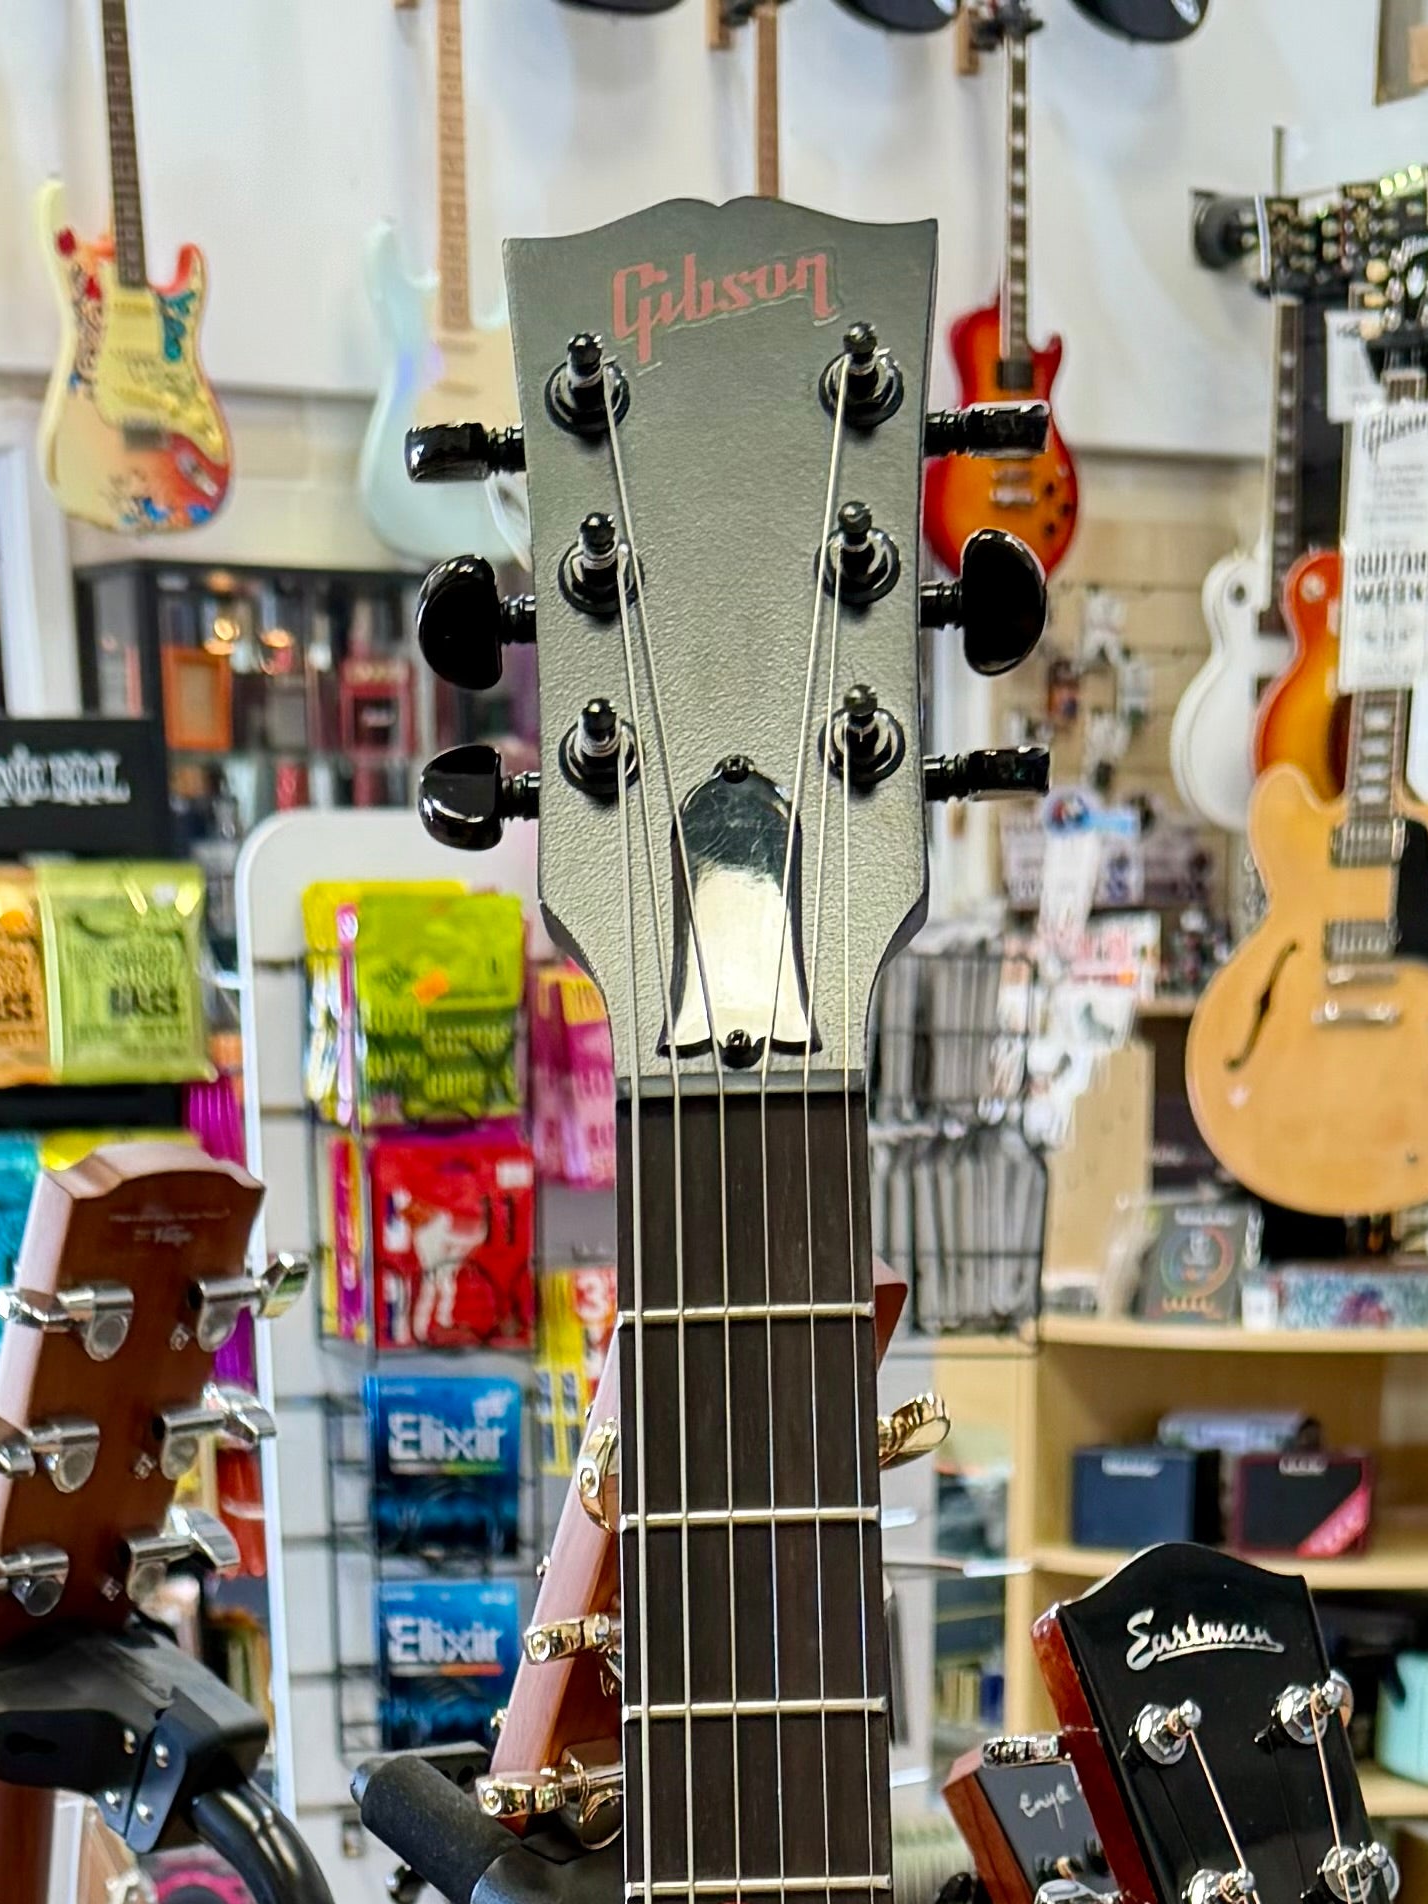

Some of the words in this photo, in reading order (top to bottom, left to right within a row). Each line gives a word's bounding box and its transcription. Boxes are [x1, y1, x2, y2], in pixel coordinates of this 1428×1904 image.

[613, 253, 837, 363] Gibson
[387, 1411, 506, 1461] Elixir
[386, 1613, 504, 1664] Elixir
[1125, 1606, 1285, 1671] Eastman
[1019, 1783, 1071, 1830] Enya
